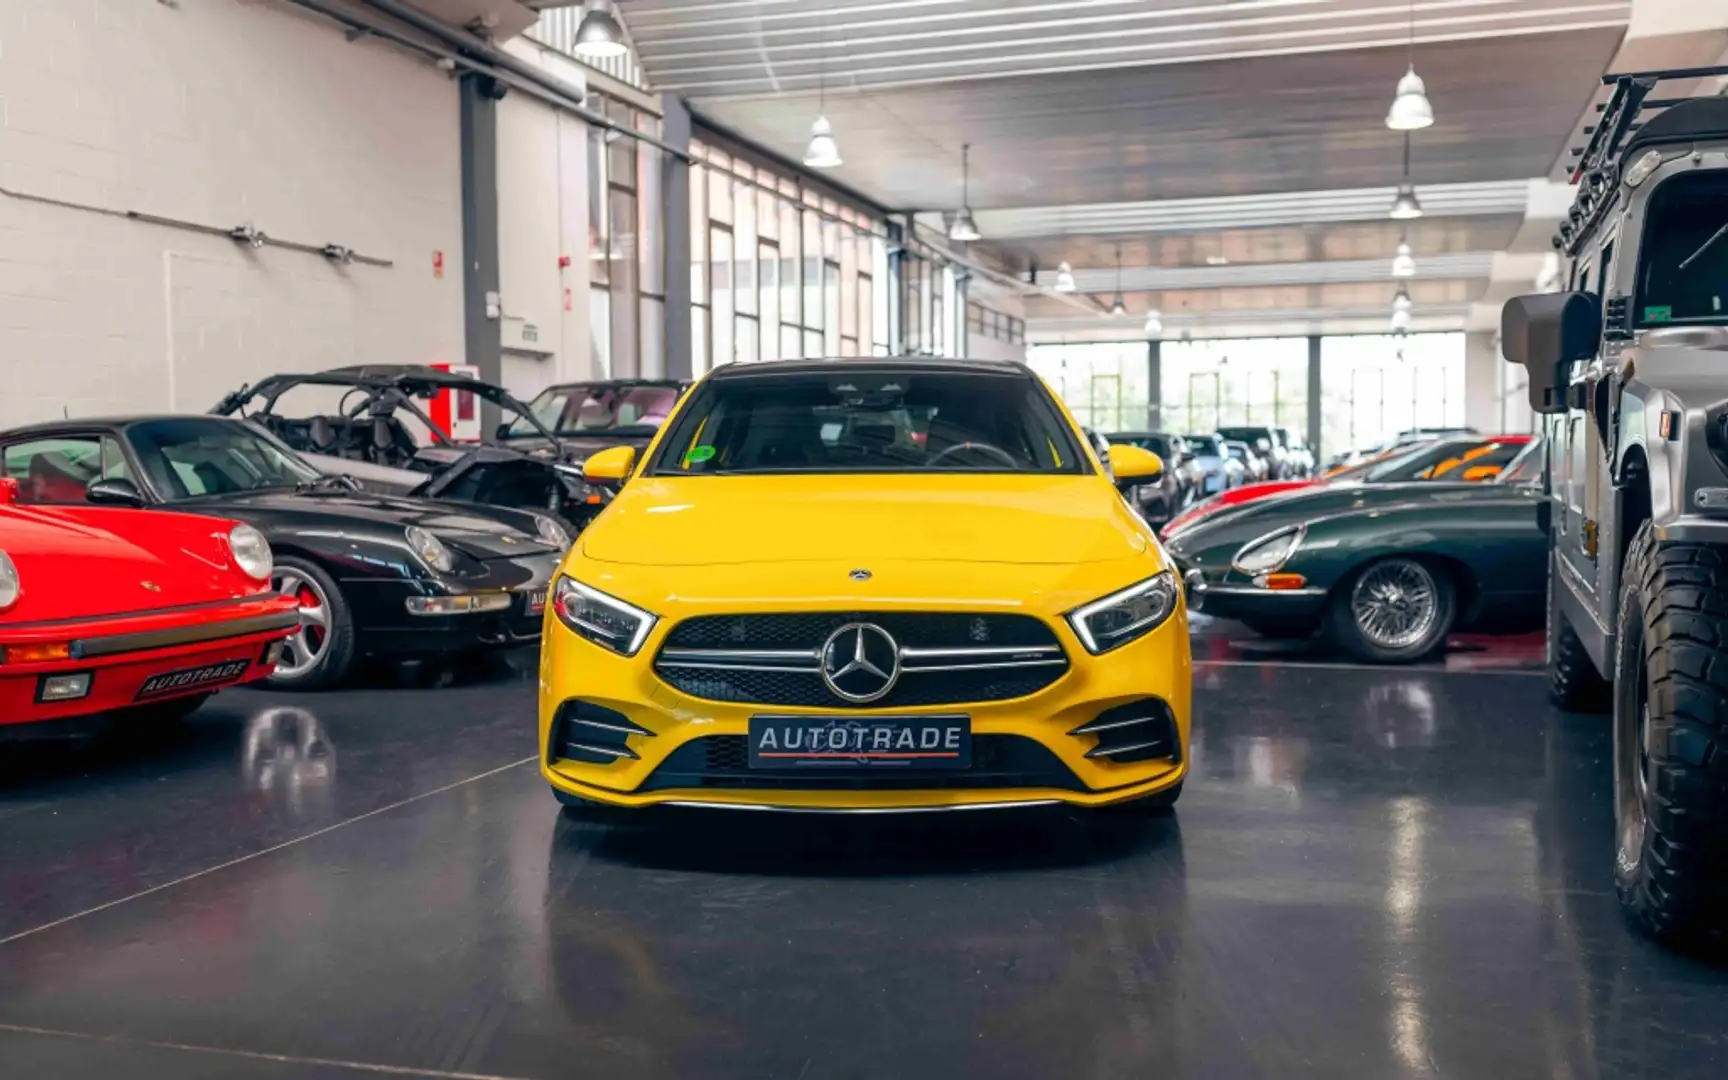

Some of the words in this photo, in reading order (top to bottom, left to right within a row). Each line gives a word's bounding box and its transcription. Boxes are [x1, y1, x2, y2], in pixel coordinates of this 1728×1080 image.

[531, 592, 546, 605] AU
[142, 661, 247, 693] AUTOTRADE
[759, 727, 962, 750] AUTOTRADE
